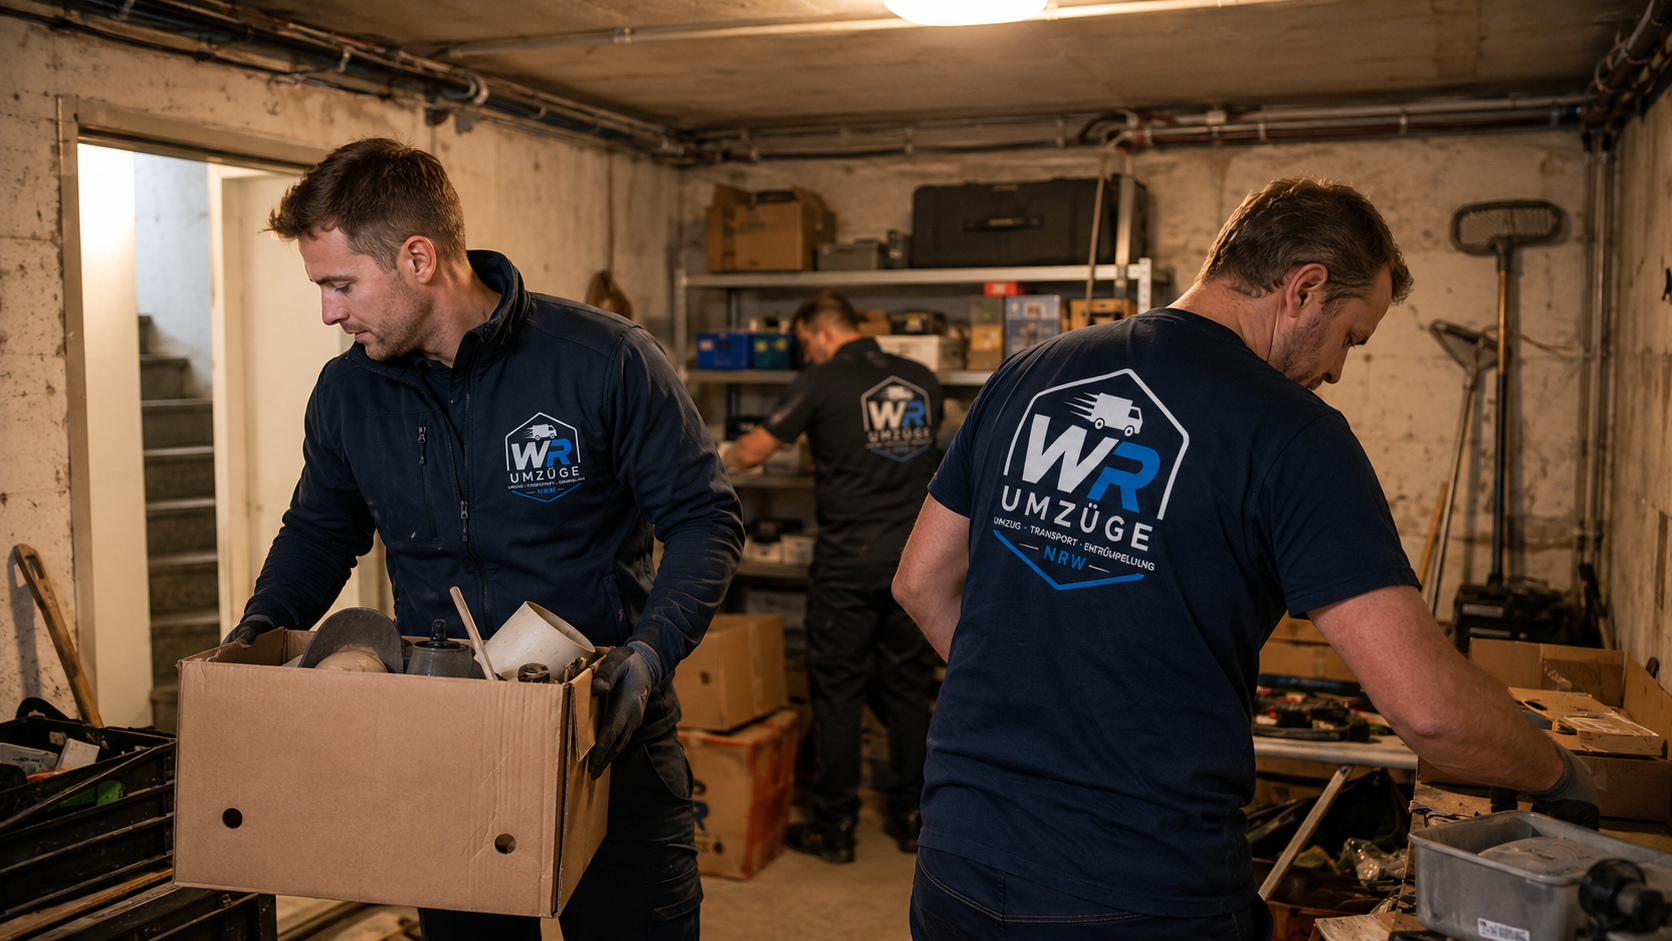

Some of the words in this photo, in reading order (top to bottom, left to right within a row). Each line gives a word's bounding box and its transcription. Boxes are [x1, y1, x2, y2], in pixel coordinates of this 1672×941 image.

[867, 400, 926, 432] WR
[511, 438, 573, 471] WR
[1022, 413, 1161, 514] WR
[510, 466, 580, 484] UMZÜGE
[993, 516, 1022, 531] UMZUG
[1030, 525, 1079, 547] TRANSPORT
[1001, 485, 1153, 552] UMZÜGE
[1043, 545, 1087, 571] NRW
